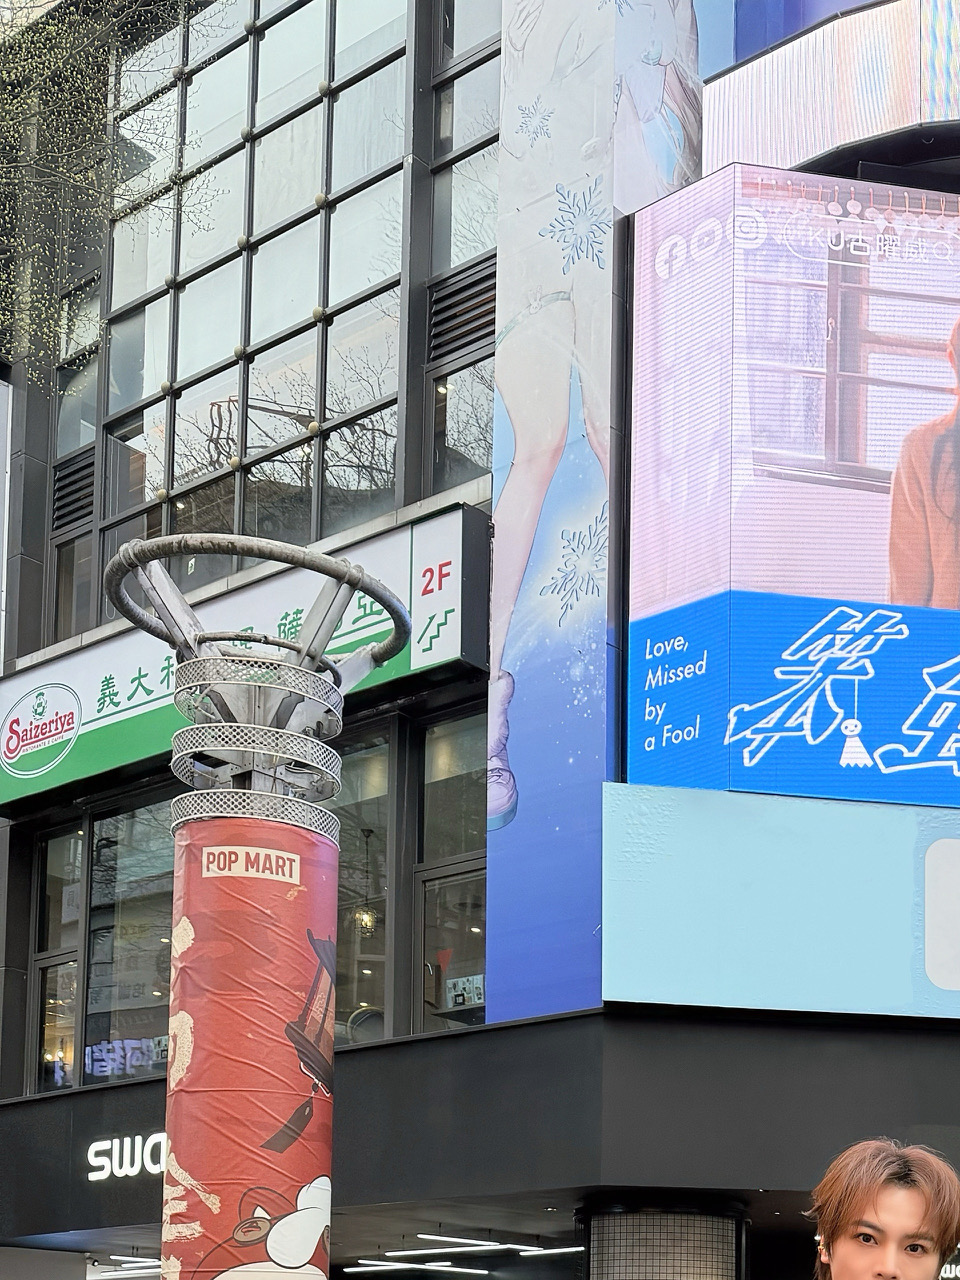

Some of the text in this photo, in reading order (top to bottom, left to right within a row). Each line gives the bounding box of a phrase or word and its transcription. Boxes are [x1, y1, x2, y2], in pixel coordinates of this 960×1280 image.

[421, 560, 453, 597] 2F
[645, 632, 690, 659] Love,
[644, 651, 708, 692] Missed
[643, 698, 667, 725] by
[3, 710, 75, 760] Saizeriya
[643, 715, 701, 752] a Fool
[206, 850, 297, 878] POP MART
[87, 1133, 168, 1181] swa
